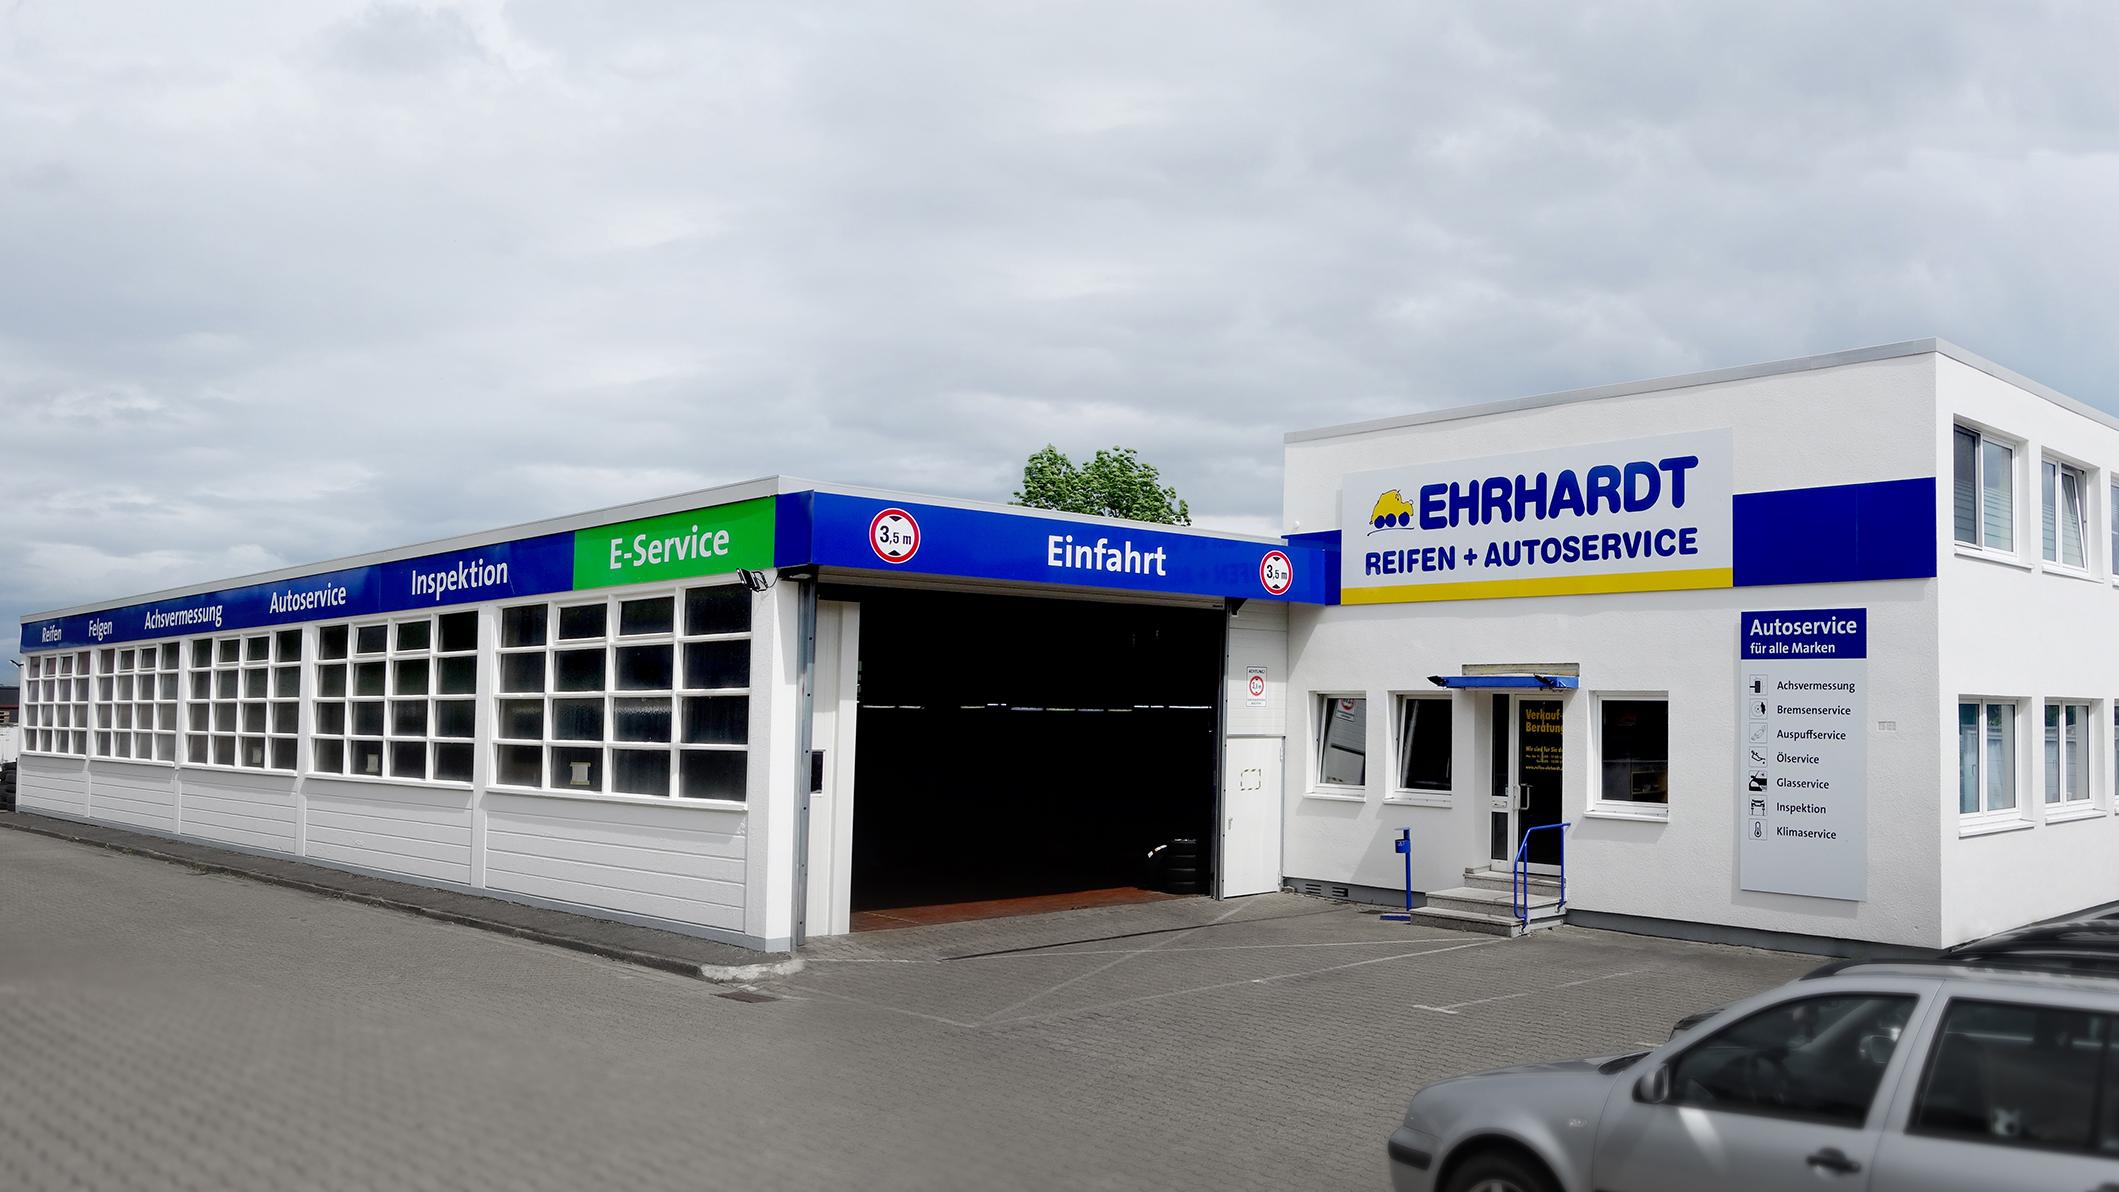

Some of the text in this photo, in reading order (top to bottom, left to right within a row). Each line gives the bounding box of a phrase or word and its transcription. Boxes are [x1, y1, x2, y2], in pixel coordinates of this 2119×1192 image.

[1419, 455, 1699, 530] EHRHARDT
[609, 525, 730, 569] E-Service
[902, 533, 912, 546] m
[1047, 535, 1166, 576] Einfahrt
[1365, 527, 1698, 576] REIFEN + AUTOSERVICE
[411, 558, 509, 600] Inspektion
[269, 582, 346, 614] Autoservice
[145, 605, 223, 630] Achsvermessung
[88, 620, 113, 641] Felgen
[1750, 616, 1857, 636] Autoservice
[42, 627, 62, 643] Reifen
[1750, 642, 1835, 654] für alle Marken
[1777, 681, 1855, 693] Achsvermessung
[1777, 705, 1851, 716] Bremsenservice
[1777, 730, 1846, 741] Auspuffservice
[1776, 752, 1820, 764] Ölservice
[1776, 778, 1830, 789] Glasservice
[1776, 802, 1826, 815] Inspektion
[1776, 826, 1836, 840] Klimaservice
